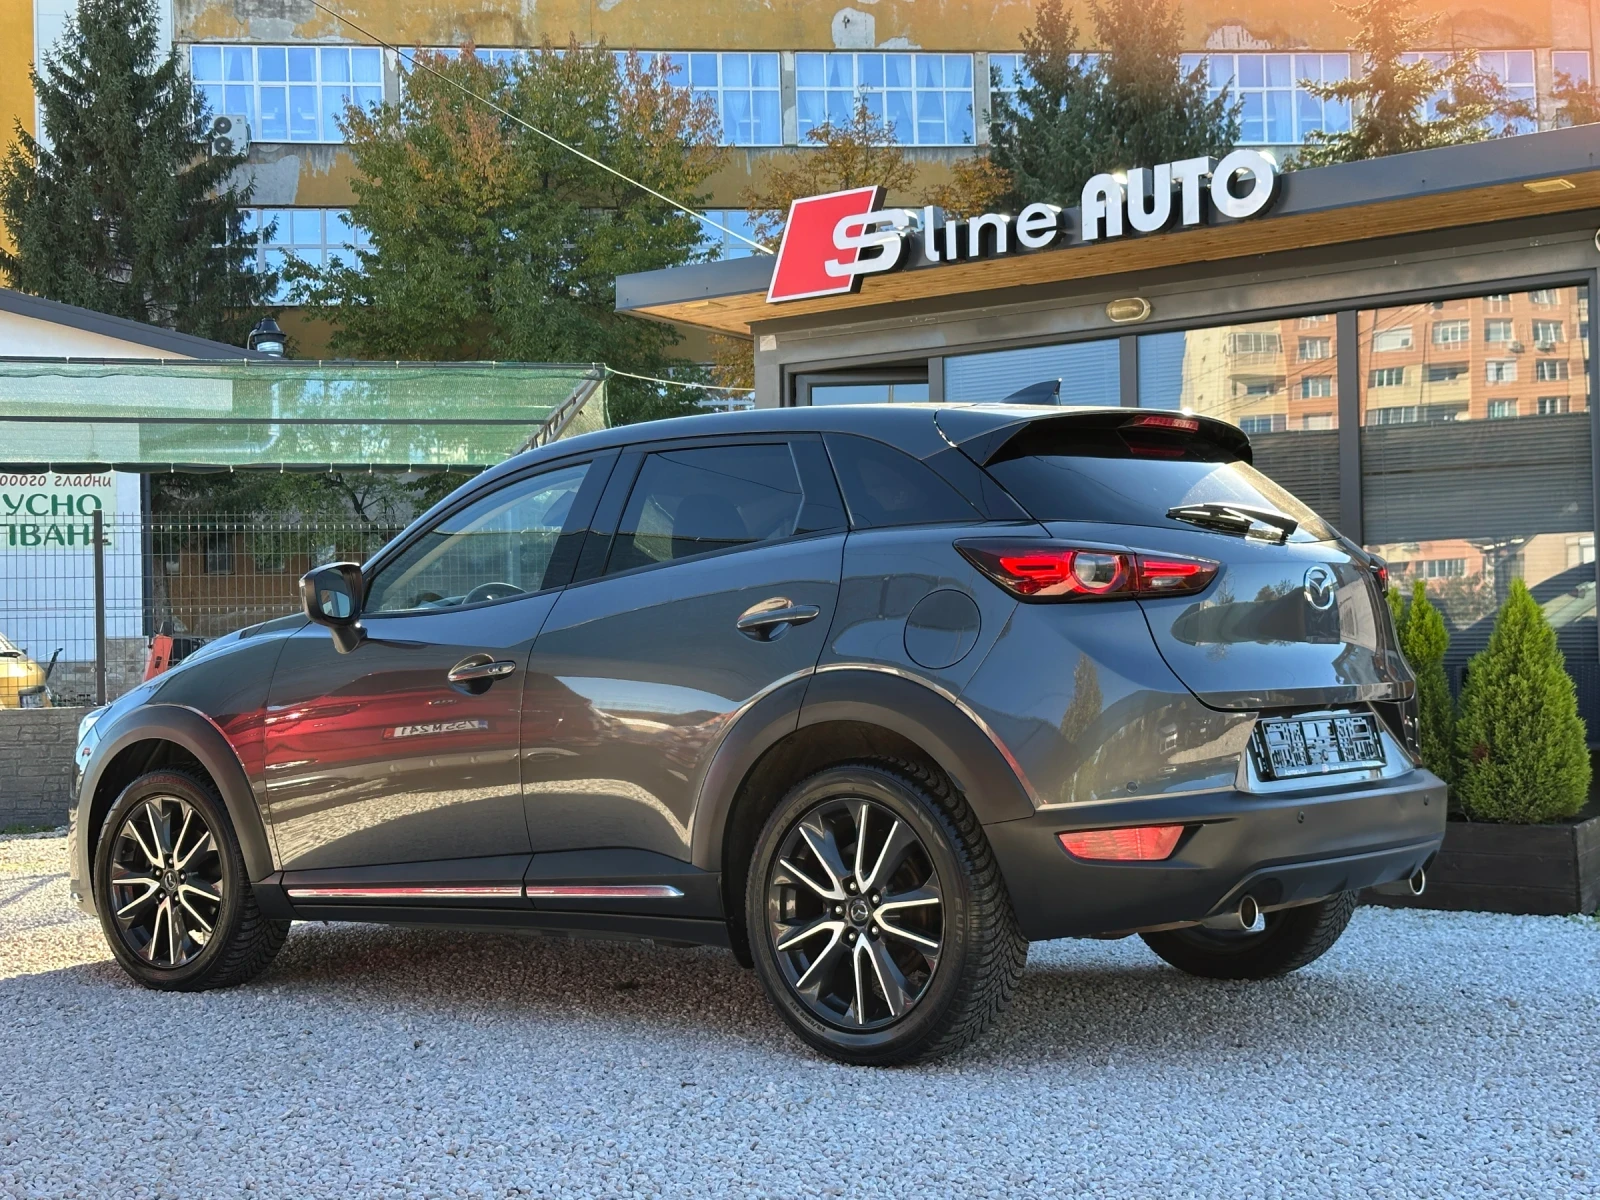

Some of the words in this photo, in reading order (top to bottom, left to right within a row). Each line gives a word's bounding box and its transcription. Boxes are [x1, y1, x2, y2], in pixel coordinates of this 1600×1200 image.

[824, 208, 909, 278] S
[924, 202, 1057, 262] line
[1081, 149, 1276, 240] AUTO
[54, 474, 112, 487] гладни
[2, 493, 102, 516] УСНО
